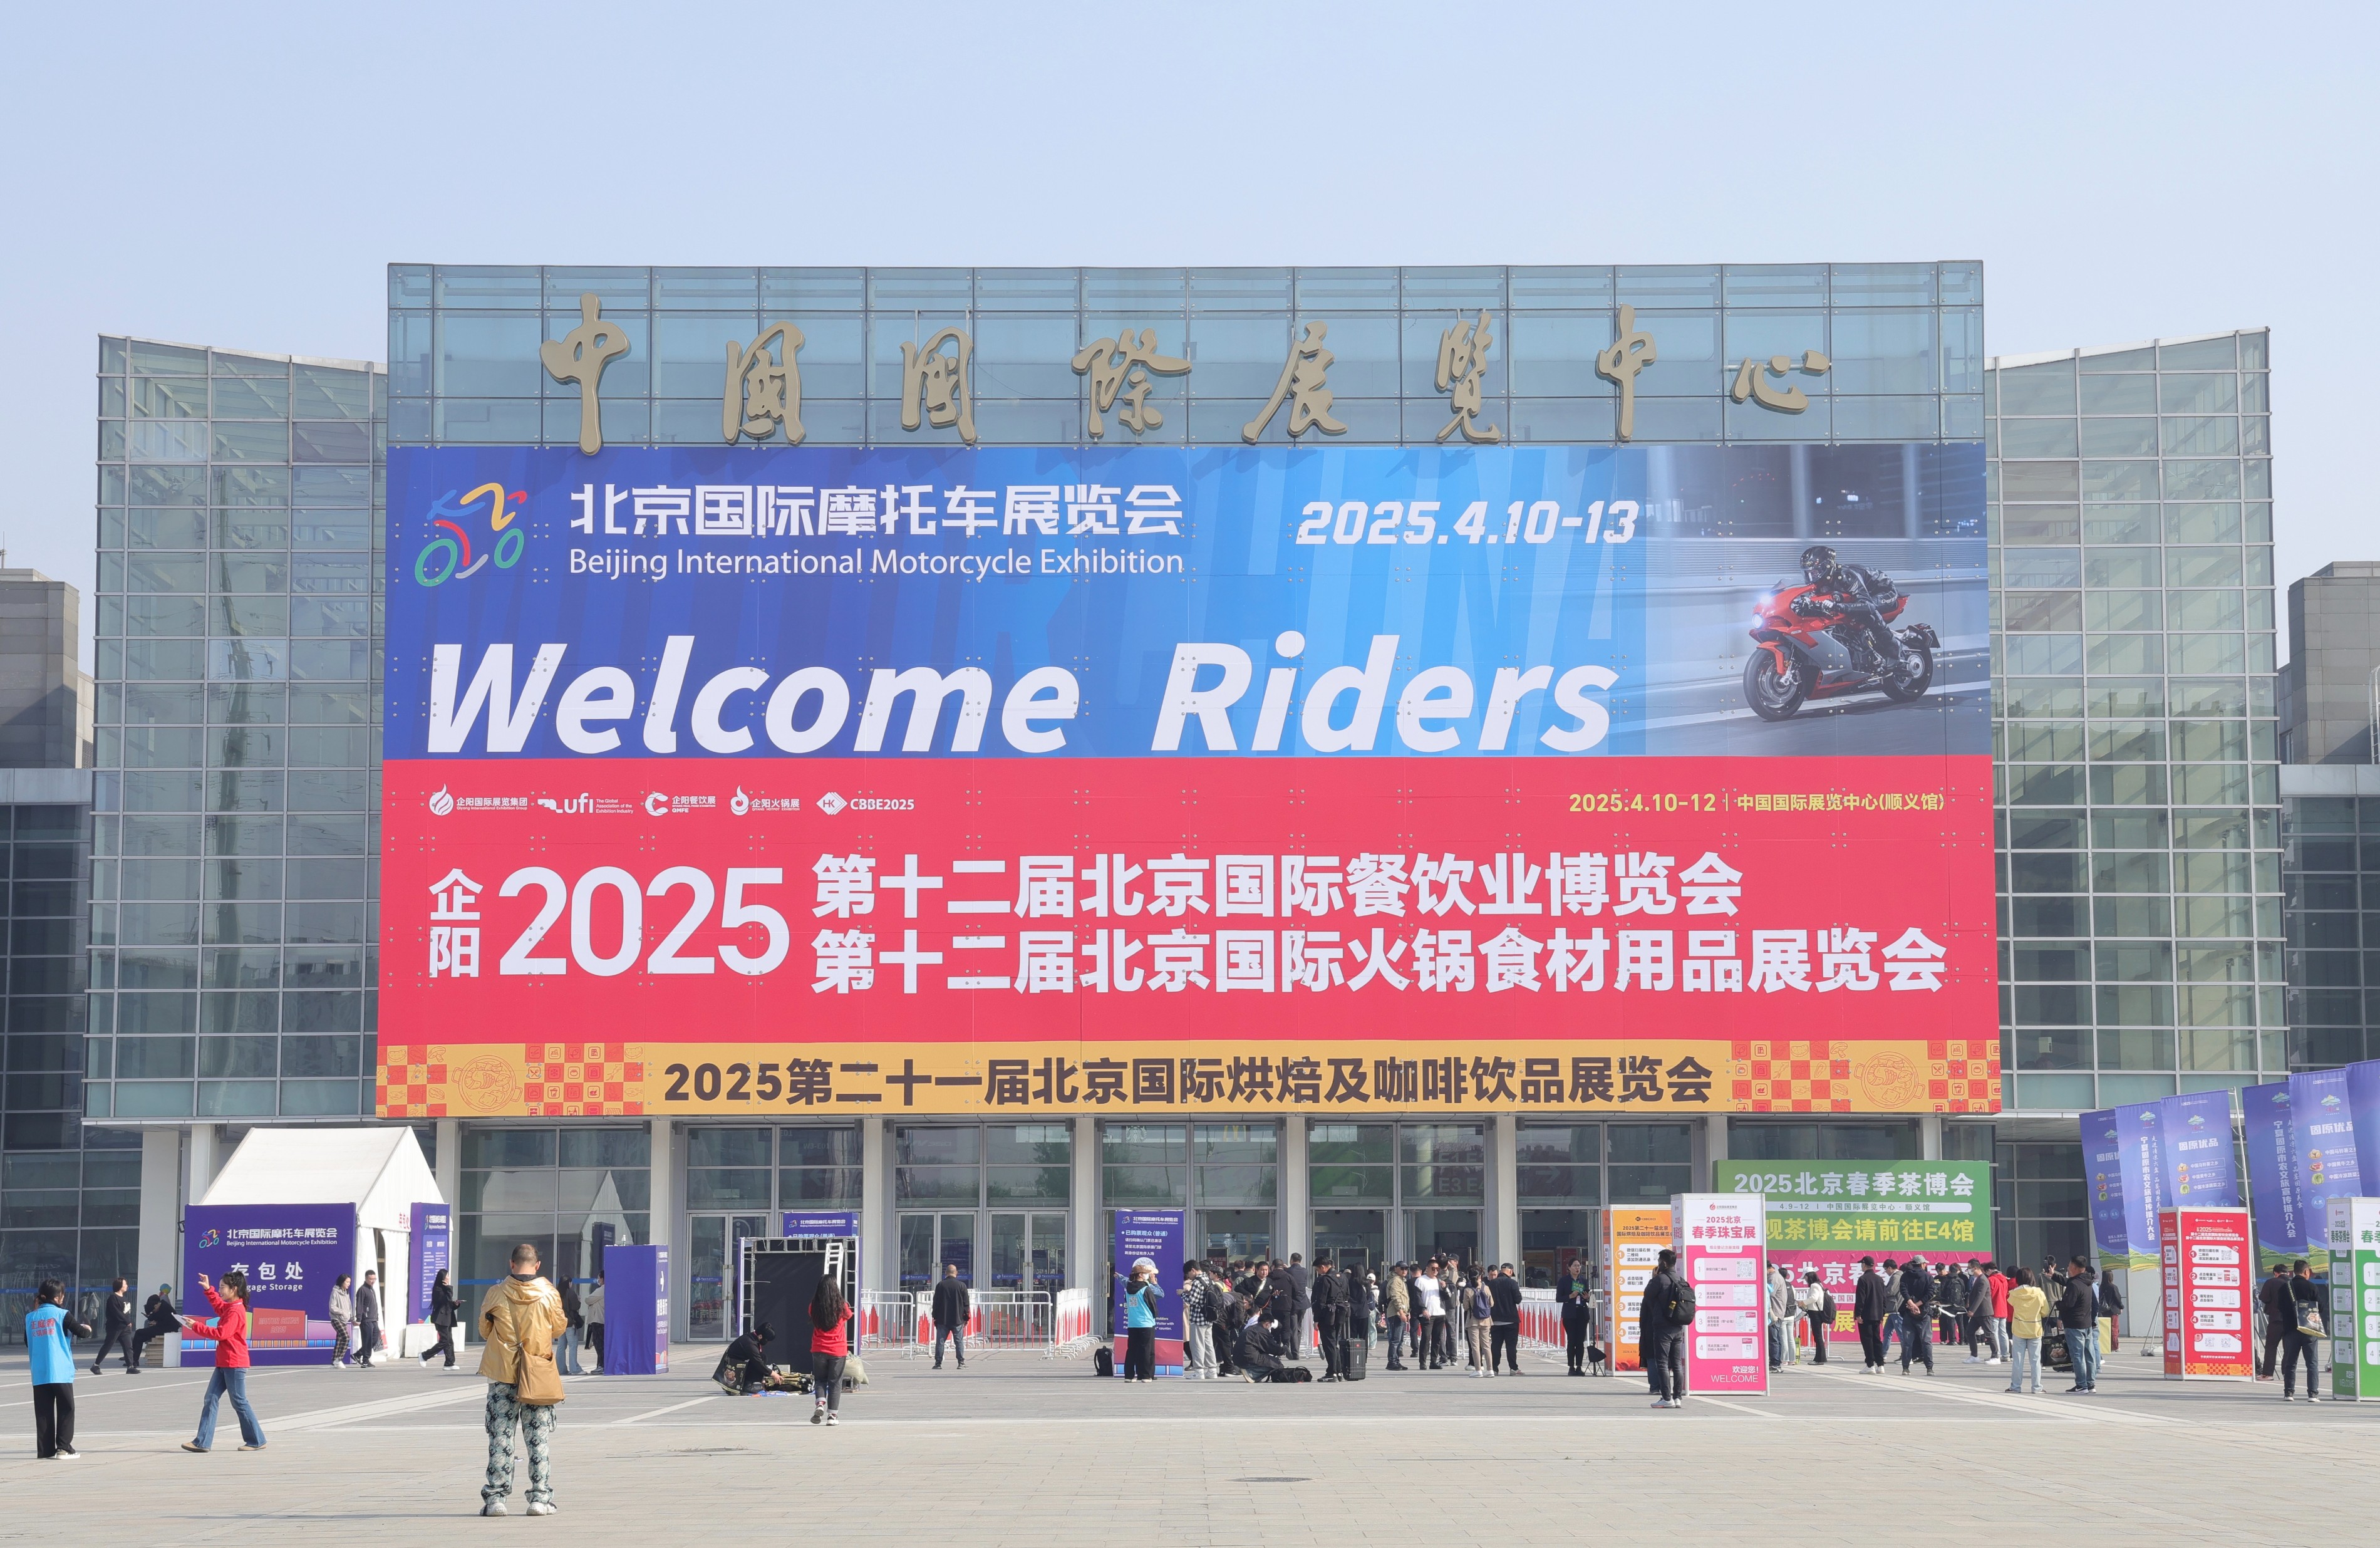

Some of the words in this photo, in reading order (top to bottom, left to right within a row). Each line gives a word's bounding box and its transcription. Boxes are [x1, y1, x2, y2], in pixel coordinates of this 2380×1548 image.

[571, 483, 1184, 536] 北京国际摩托车展览会
[1295, 501, 1639, 544] 2025.4.10-13
[569, 549, 667, 580] Beijing
[677, 549, 862, 574] International
[872, 549, 1032, 580] Motorcycle
[1041, 549, 1184, 574] Exhibition
[427, 635, 1080, 754] Welcome
[1151, 630, 1614, 752] Riders
[457, 797, 528, 806] 企阳国际展览集团
[564, 792, 593, 813] ufi
[672, 796, 716, 804] 企阳餐饮展
[752, 799, 800, 808] 企阳火锅展
[823, 799, 836, 808] HK
[851, 798, 914, 810] CBBE2025
[1570, 793, 1715, 812] 2025.4.10-12
[1737, 792, 1944, 812] 中国国际展览中心(顺义馆)
[812, 851, 1742, 918] 第十二届北京国际餐饮业博览会
[428, 868, 482, 979] 企阳
[499, 865, 789, 977] 2025
[811, 927, 1947, 994] 第十二届北京国际火锅食材用品展览会
[664, 1055, 1712, 1106] 2025第二十一届北京国际烘焙及咖啡饮品展览会
[2178, 1138, 2218, 1151] 固原优品
[1734, 1171, 1974, 1197] 2025北京春季茶博会
[2141, 1136, 2156, 1240] 宁夏固原市农文旅宣传推介大会
[2274, 1120, 2297, 1238] 宁夏固原市农文旅宣传推介大会
[227, 1228, 338, 1239] 北京国际摩托车展览会
[1692, 1226, 1756, 1239] 春季珠宝展
[231, 1261, 304, 1280] 存包处
[269, 1283, 303, 1292] Storage
